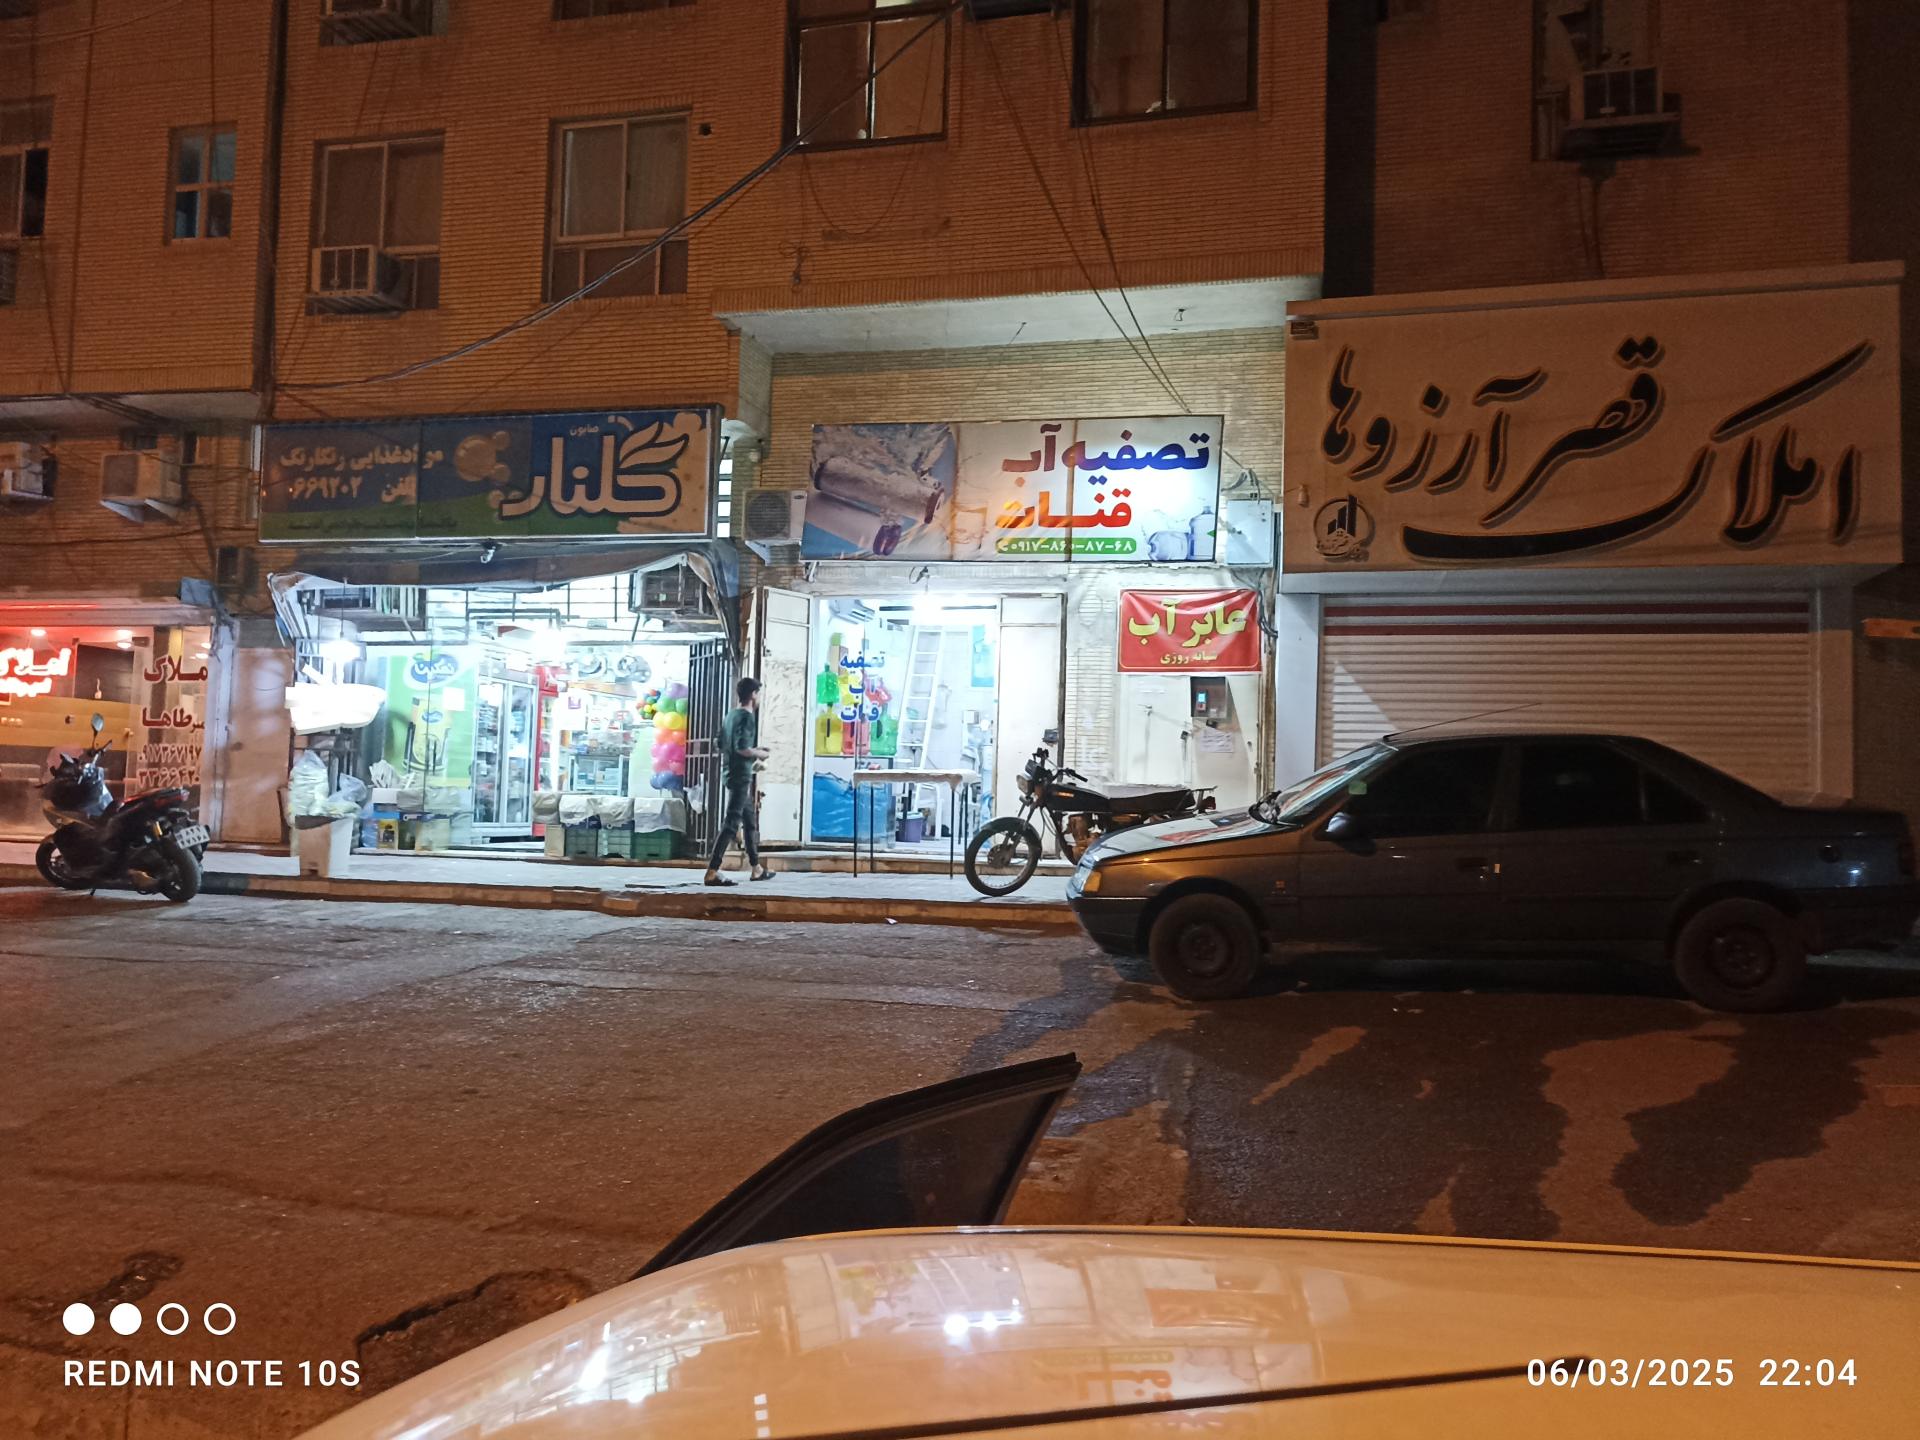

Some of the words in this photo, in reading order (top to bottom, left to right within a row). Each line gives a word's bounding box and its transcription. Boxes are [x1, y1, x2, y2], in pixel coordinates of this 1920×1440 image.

[1322, 345, 1545, 492] آرزوها
[1000, 423, 1063, 488] آب
[1060, 429, 1211, 485] تصفیه
[995, 488, 1133, 529] قنات
[1128, 597, 1177, 646] آب
[1181, 604, 1248, 648] عابر
[143, 655, 208, 682] ملاک
